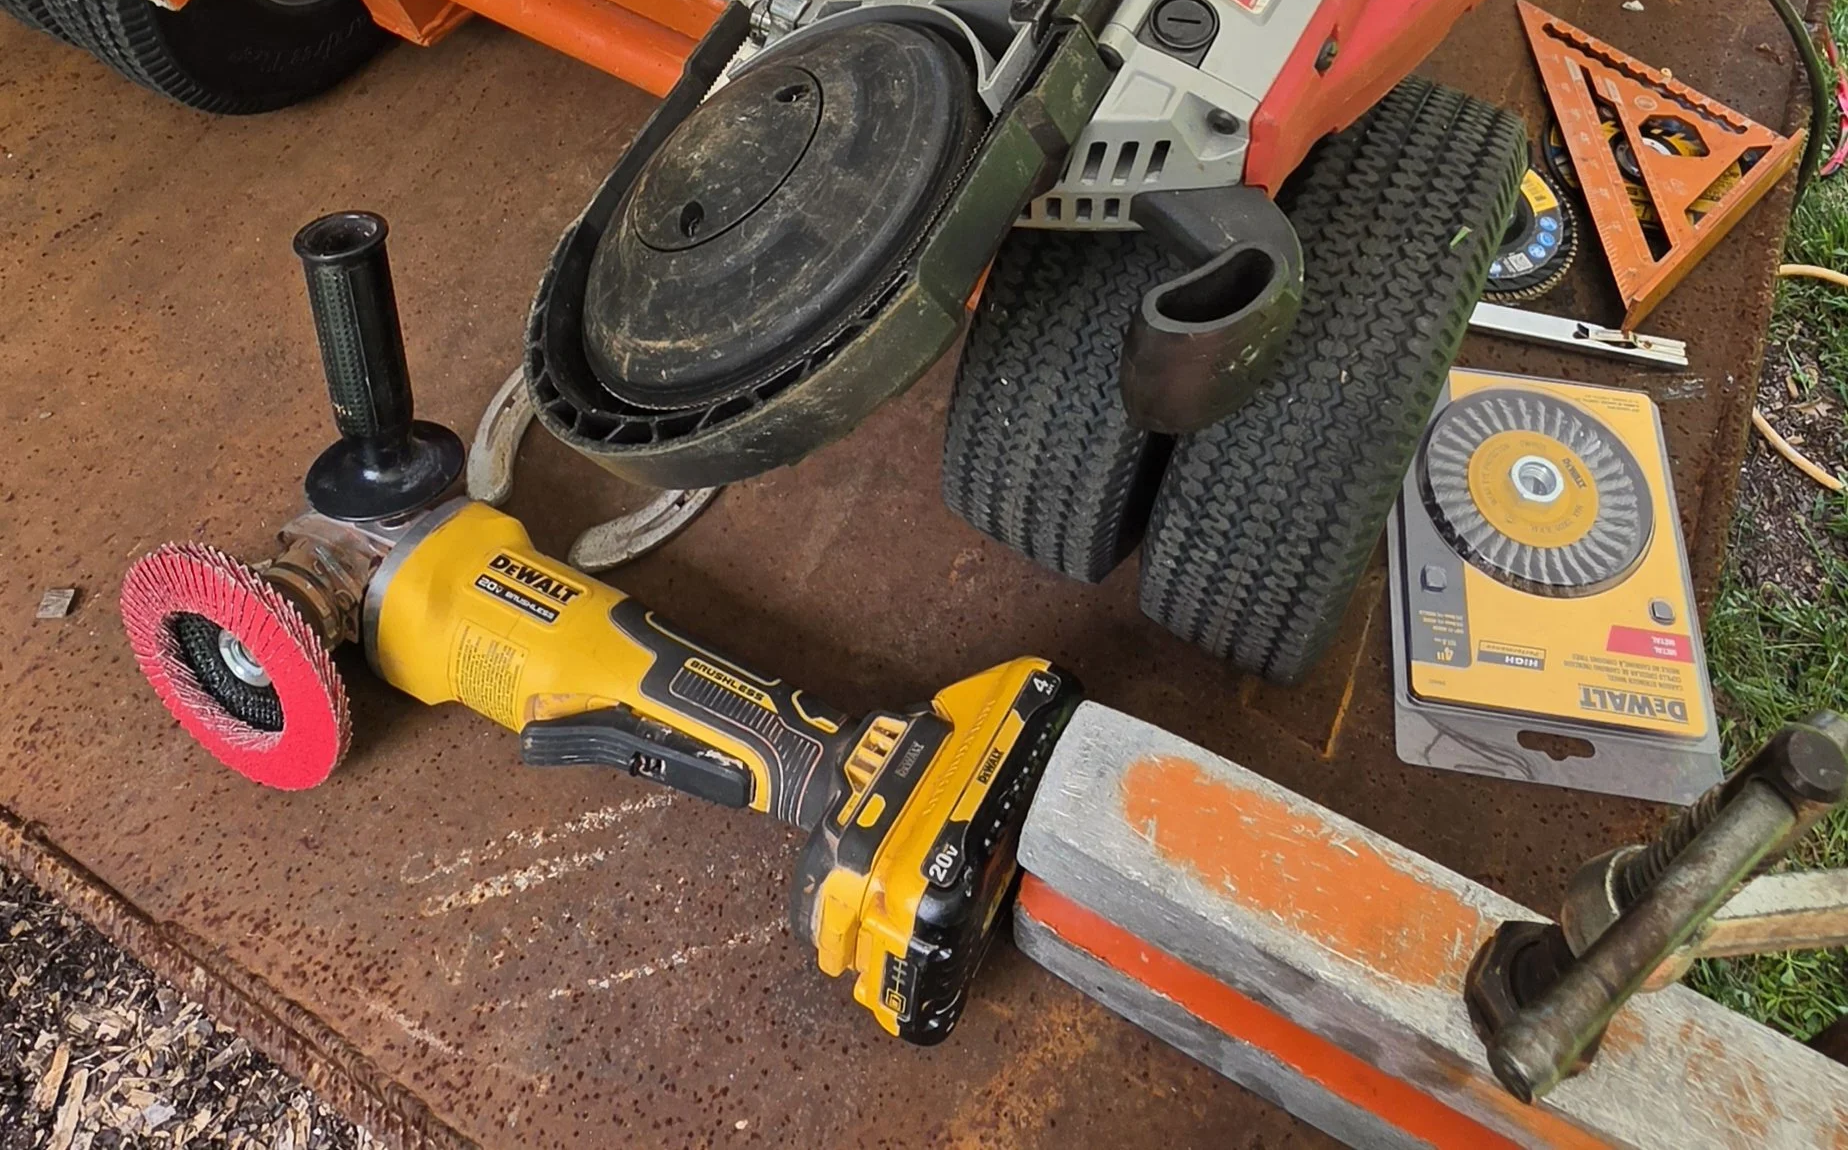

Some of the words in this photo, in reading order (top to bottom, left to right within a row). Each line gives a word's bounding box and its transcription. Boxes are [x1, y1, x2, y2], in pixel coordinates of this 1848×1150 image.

[503, 590, 555, 619] BRUSHLESS
[1504, 654, 1538, 667] HIGH
[689, 659, 765, 702] BRUSHLESS
[1032, 677, 1049, 693] 4
